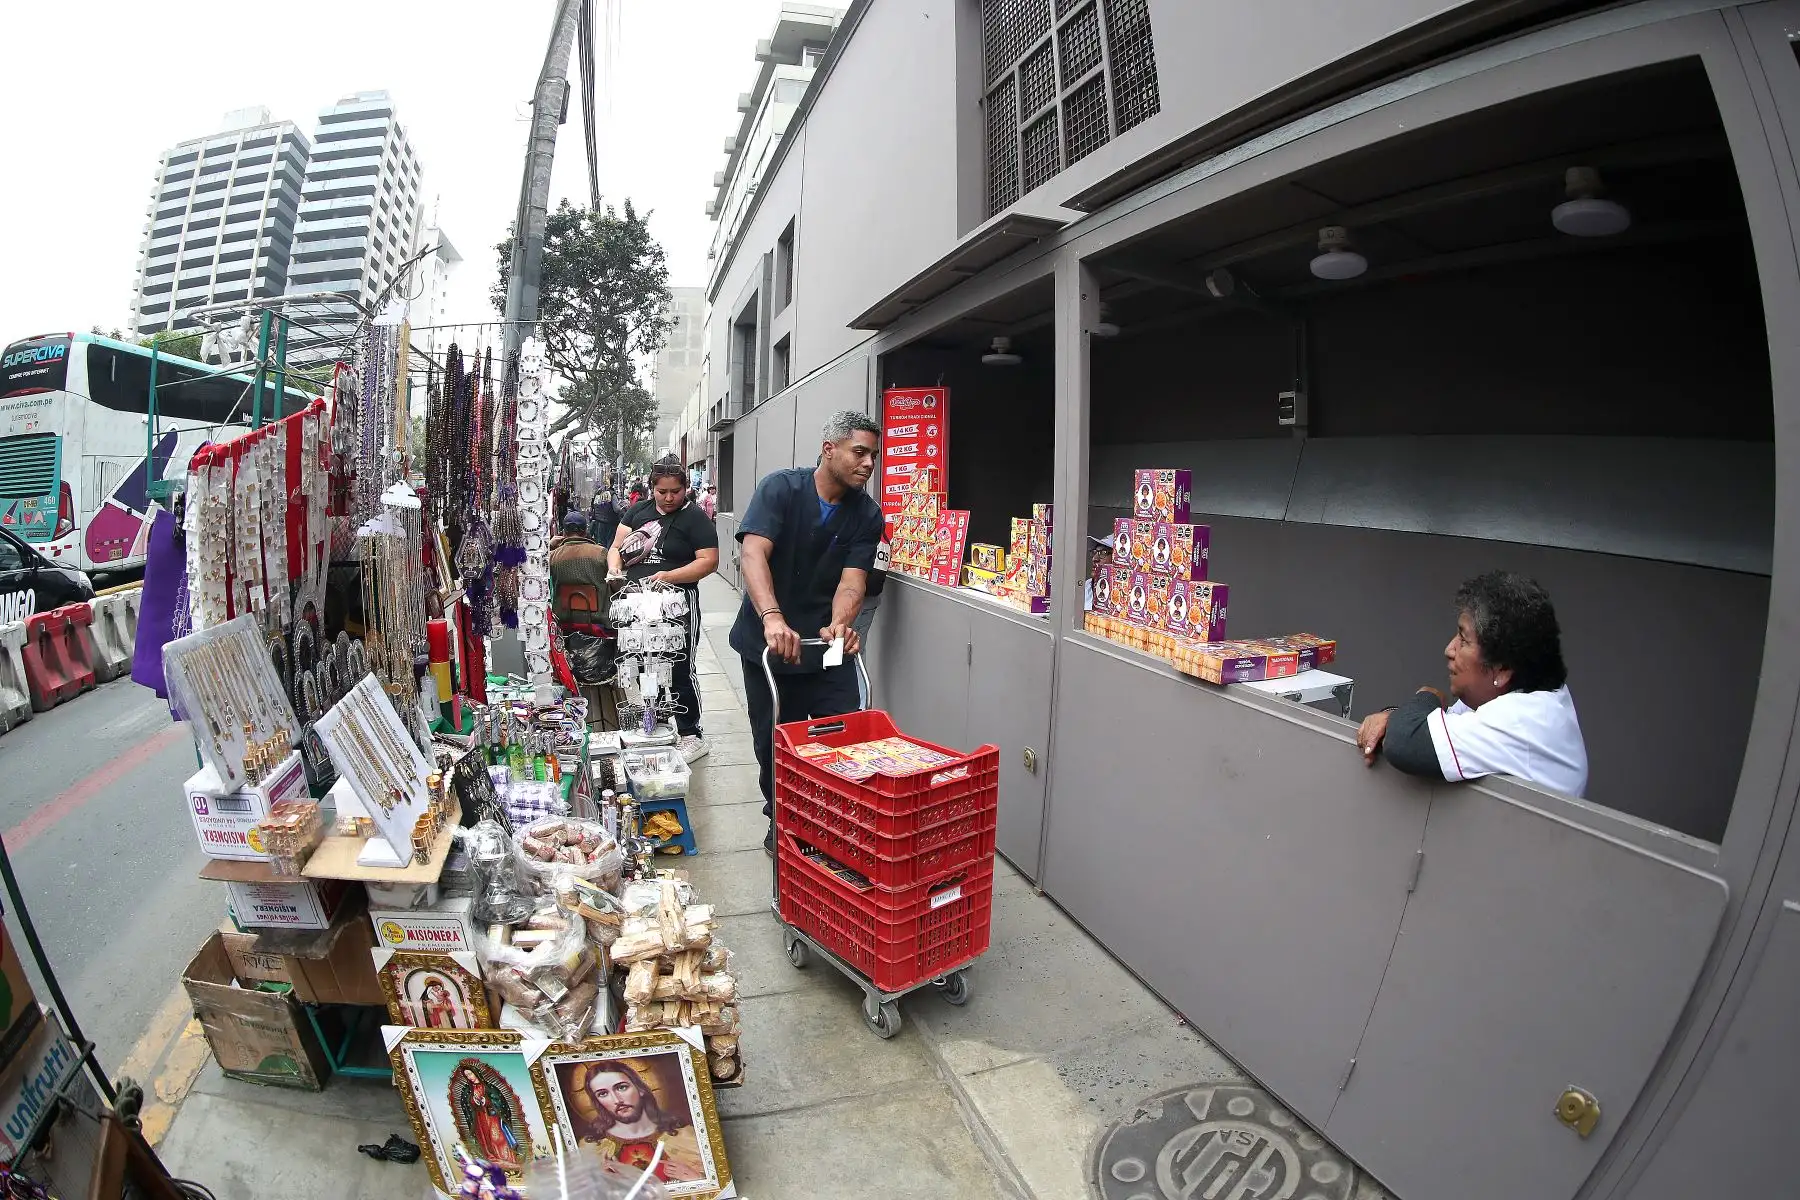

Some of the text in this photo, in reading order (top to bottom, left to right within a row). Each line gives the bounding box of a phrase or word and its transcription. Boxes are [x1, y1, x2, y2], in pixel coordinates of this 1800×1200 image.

[3, 344, 65, 369] SUPERCIVA
[0, 398, 53, 411] www.civa.com.pe
[44, 496, 56, 505] 460
[194, 797, 207, 811] 10
[202, 829, 247, 844] MISIONERA
[253, 904, 297, 913] MISIONERA
[406, 930, 461, 941] MISIONERA
[5, 1038, 70, 1140] unifrutti
